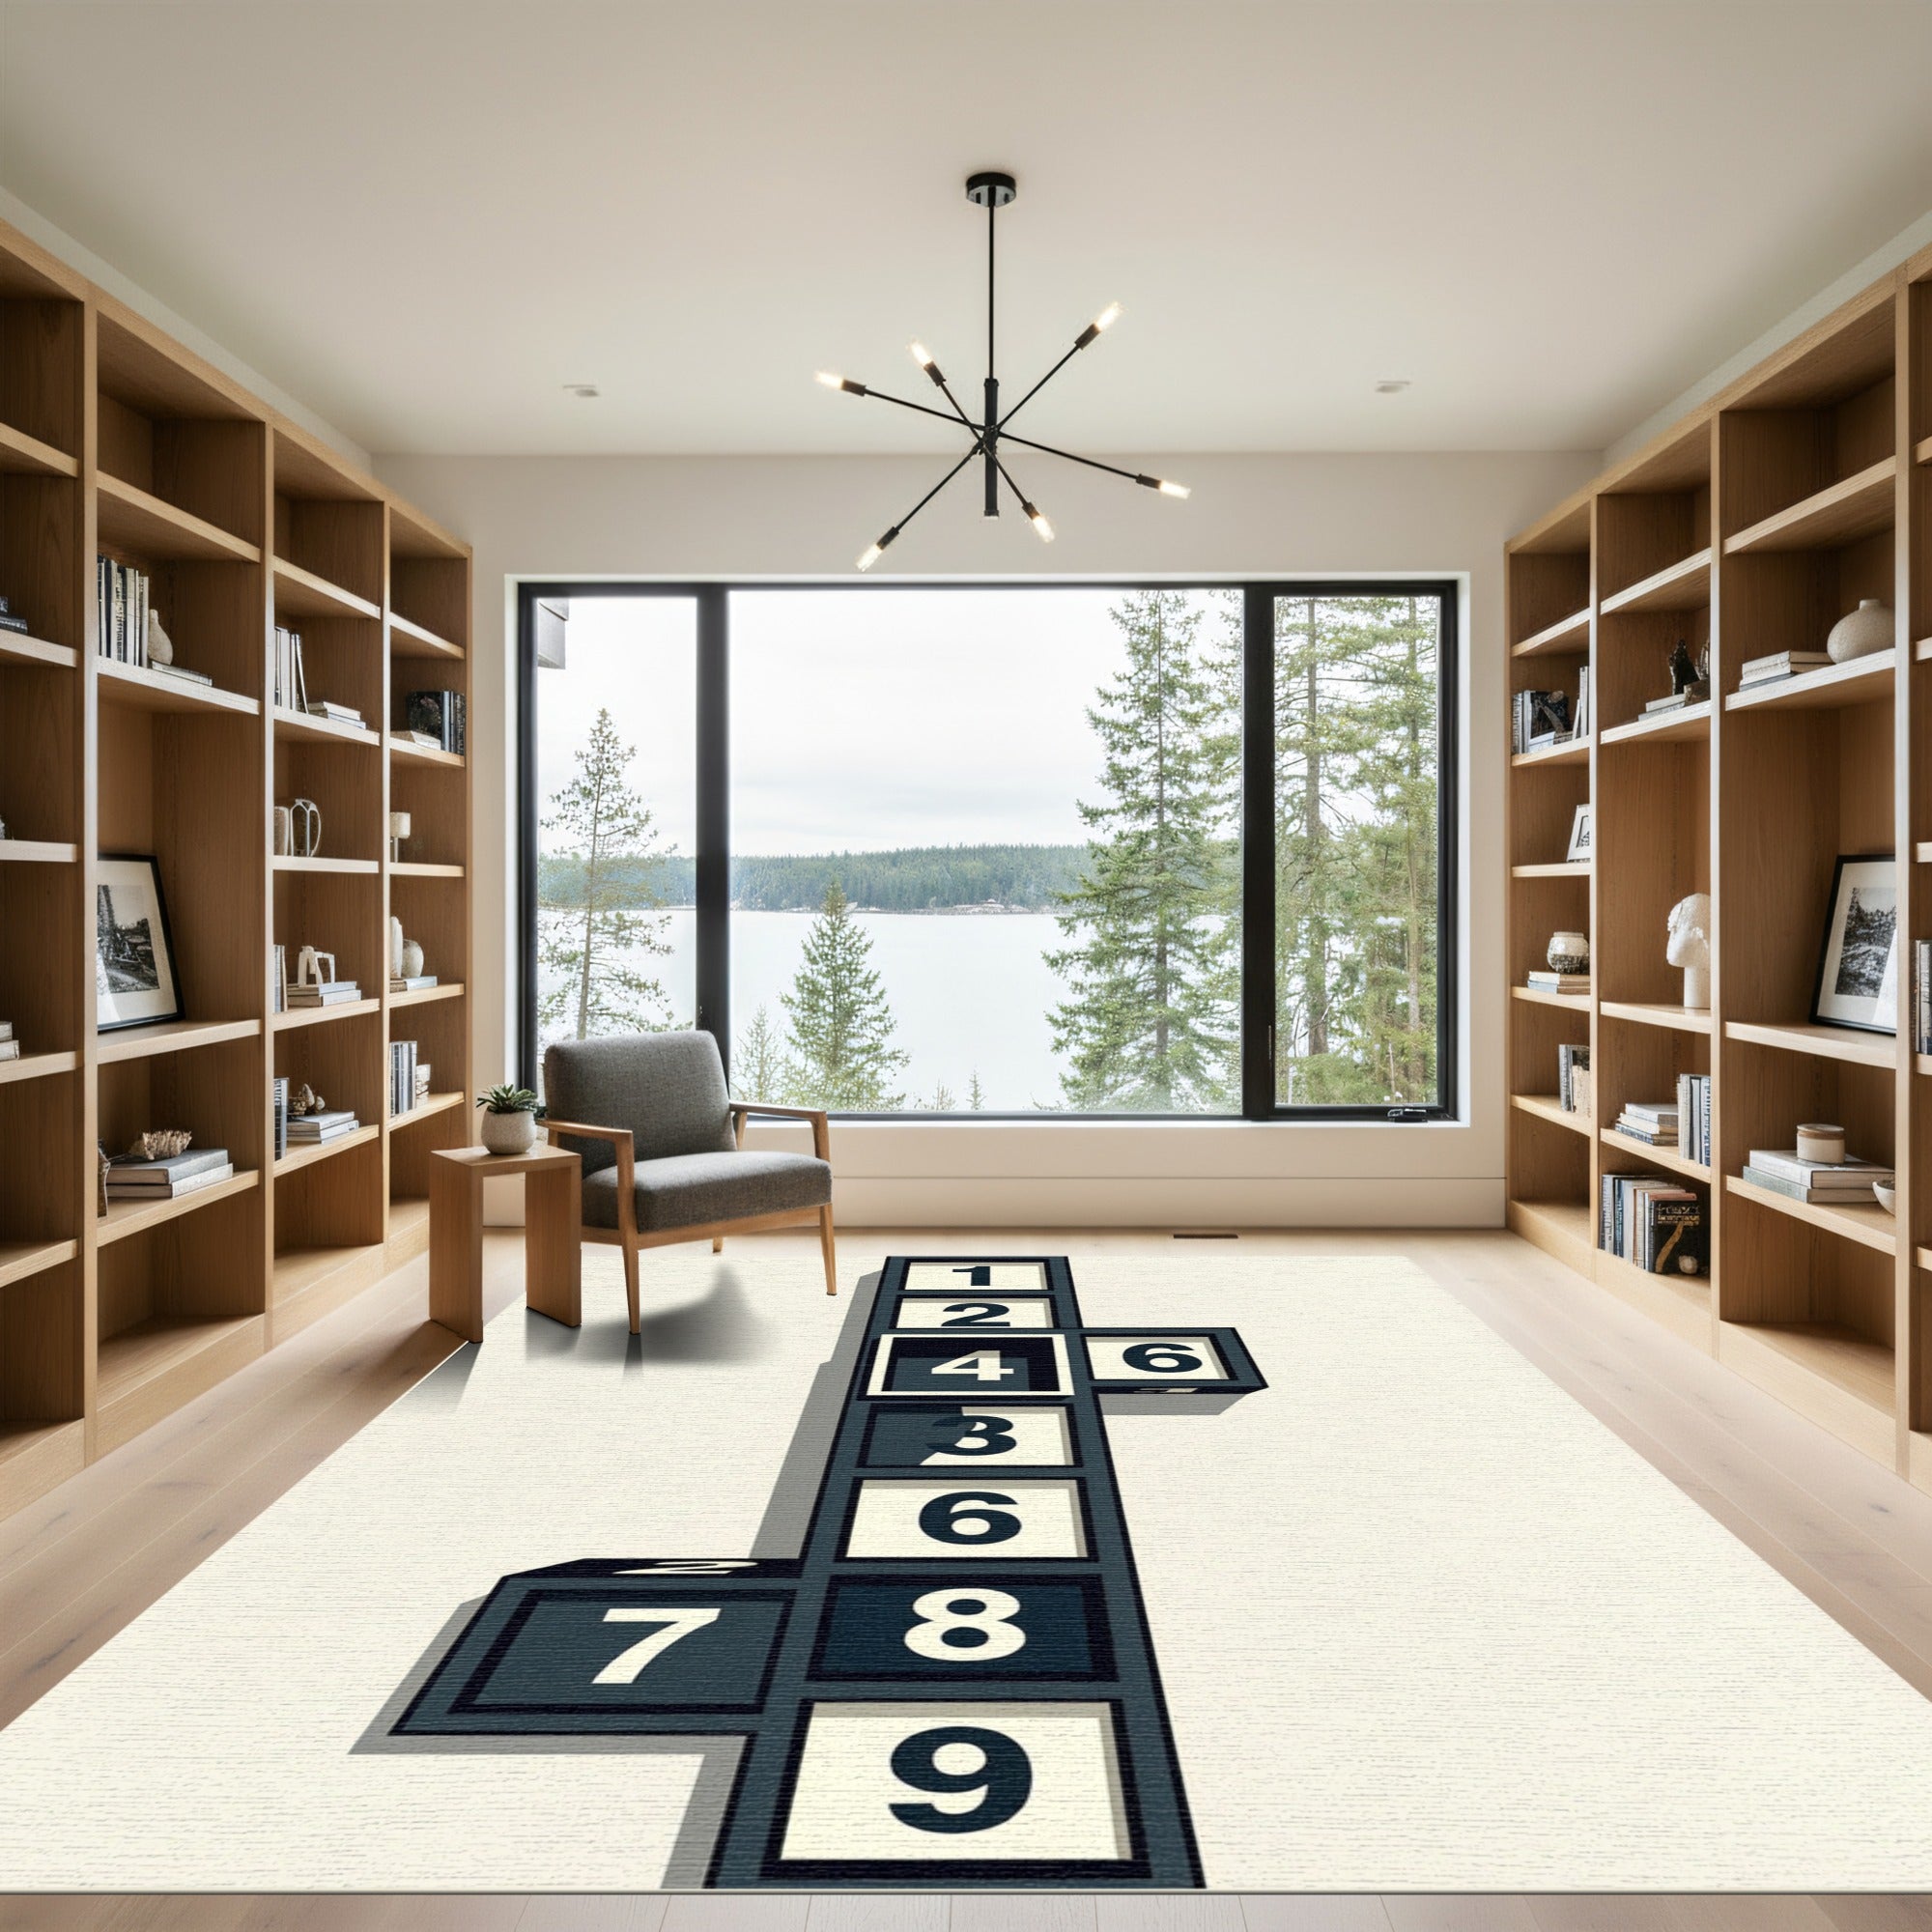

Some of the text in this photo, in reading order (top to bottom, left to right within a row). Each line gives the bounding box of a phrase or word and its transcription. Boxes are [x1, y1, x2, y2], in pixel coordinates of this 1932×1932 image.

[952, 1265, 991, 1287] 1
[941, 1302, 1010, 1327] 2
[930, 1350, 1014, 1381] 4
[1122, 1343, 1203, 1373] 6
[925, 1415, 1017, 1456] 3
[918, 1492, 1022, 1545] 6
[903, 1587, 1026, 1662] 8
[591, 1607, 722, 1684] 7
[889, 1725, 1033, 1833] 9
